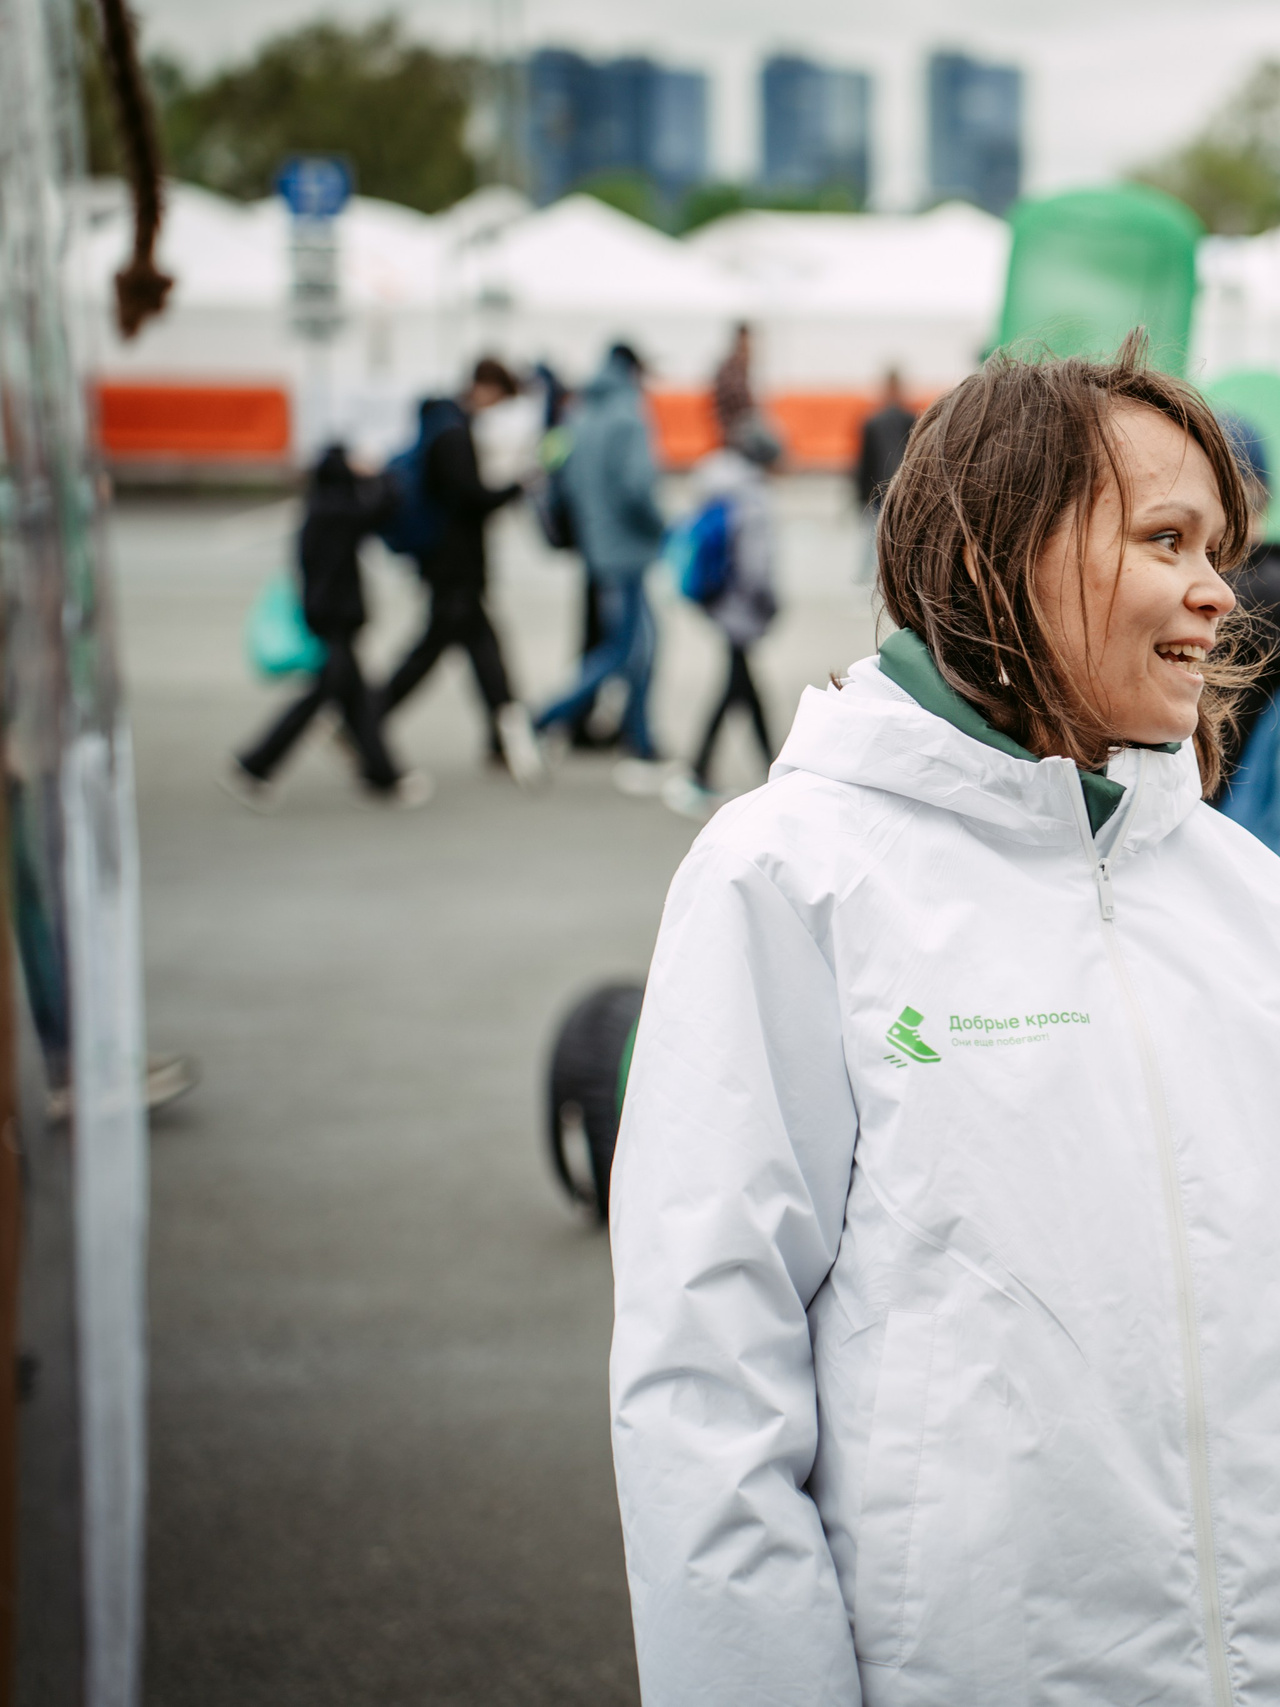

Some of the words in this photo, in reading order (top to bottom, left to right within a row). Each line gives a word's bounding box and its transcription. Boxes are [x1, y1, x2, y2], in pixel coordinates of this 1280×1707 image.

[949, 1015, 1020, 1033] Добрые
[1025, 1011, 1090, 1028] кроссы
[951, 1037, 972, 1047] Они
[997, 1032, 1050, 1047] побегают!
